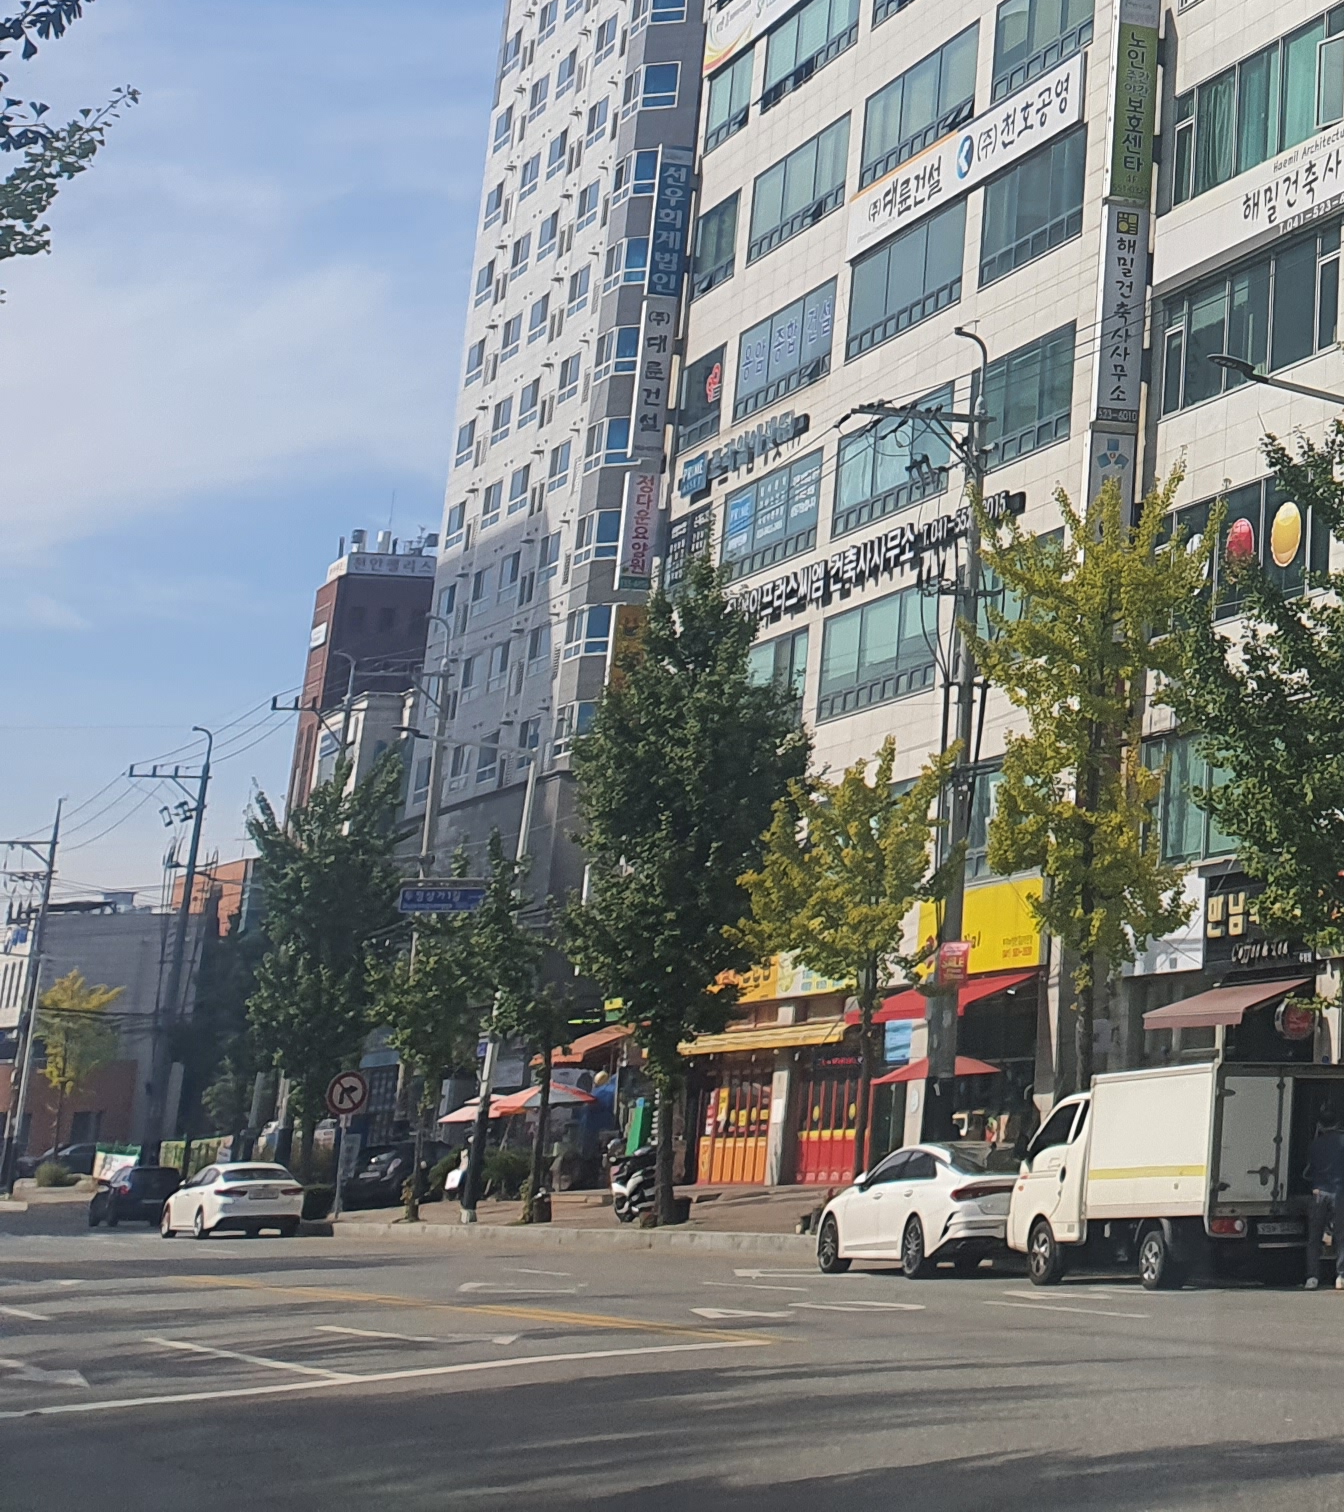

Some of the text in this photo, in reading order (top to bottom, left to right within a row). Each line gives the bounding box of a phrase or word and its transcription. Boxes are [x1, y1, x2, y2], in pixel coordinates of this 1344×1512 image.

[1127, 31, 1148, 70] 노인
[1121, 96, 1145, 173] 보호센타
[651, 164, 687, 294] 선우회계법인
[1108, 236, 1137, 403] 해밀건축사사무소
